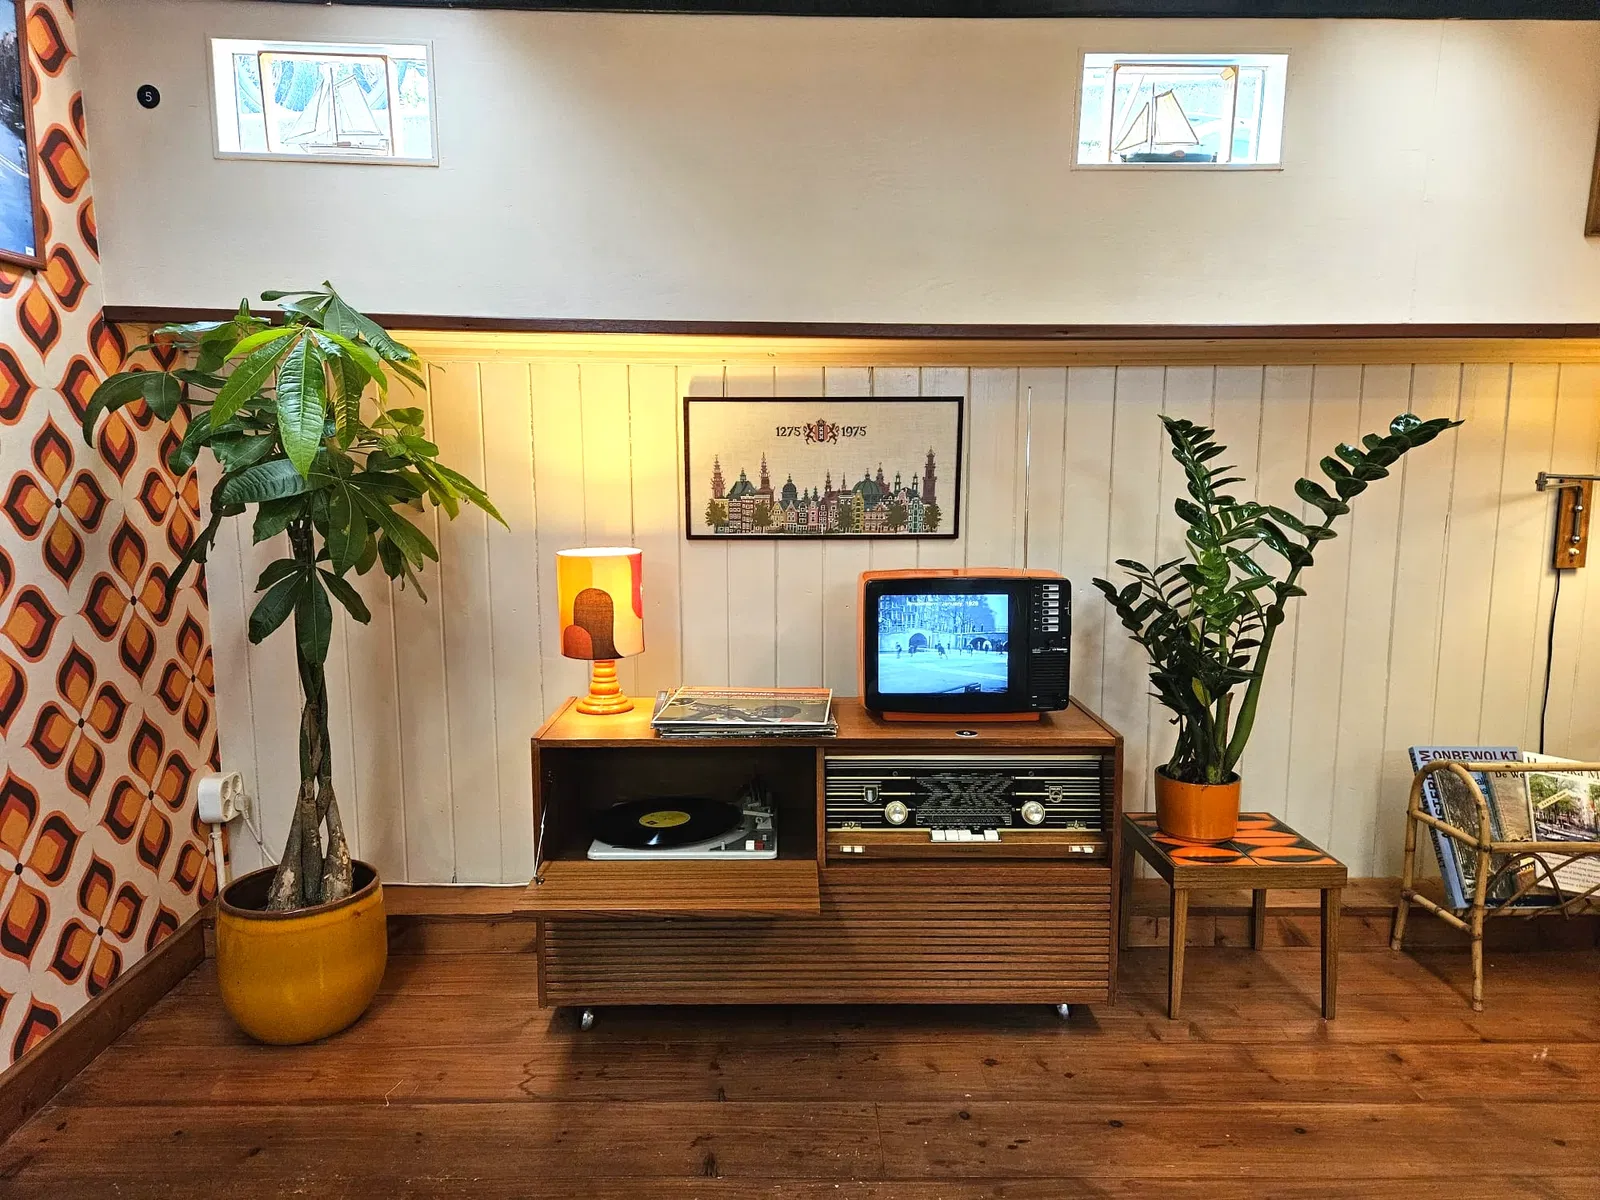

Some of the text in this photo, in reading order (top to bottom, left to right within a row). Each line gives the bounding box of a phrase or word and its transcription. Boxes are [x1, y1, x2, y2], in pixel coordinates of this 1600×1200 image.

[145, 91, 153, 102] 5
[775, 425, 867, 437] 1275 1975
